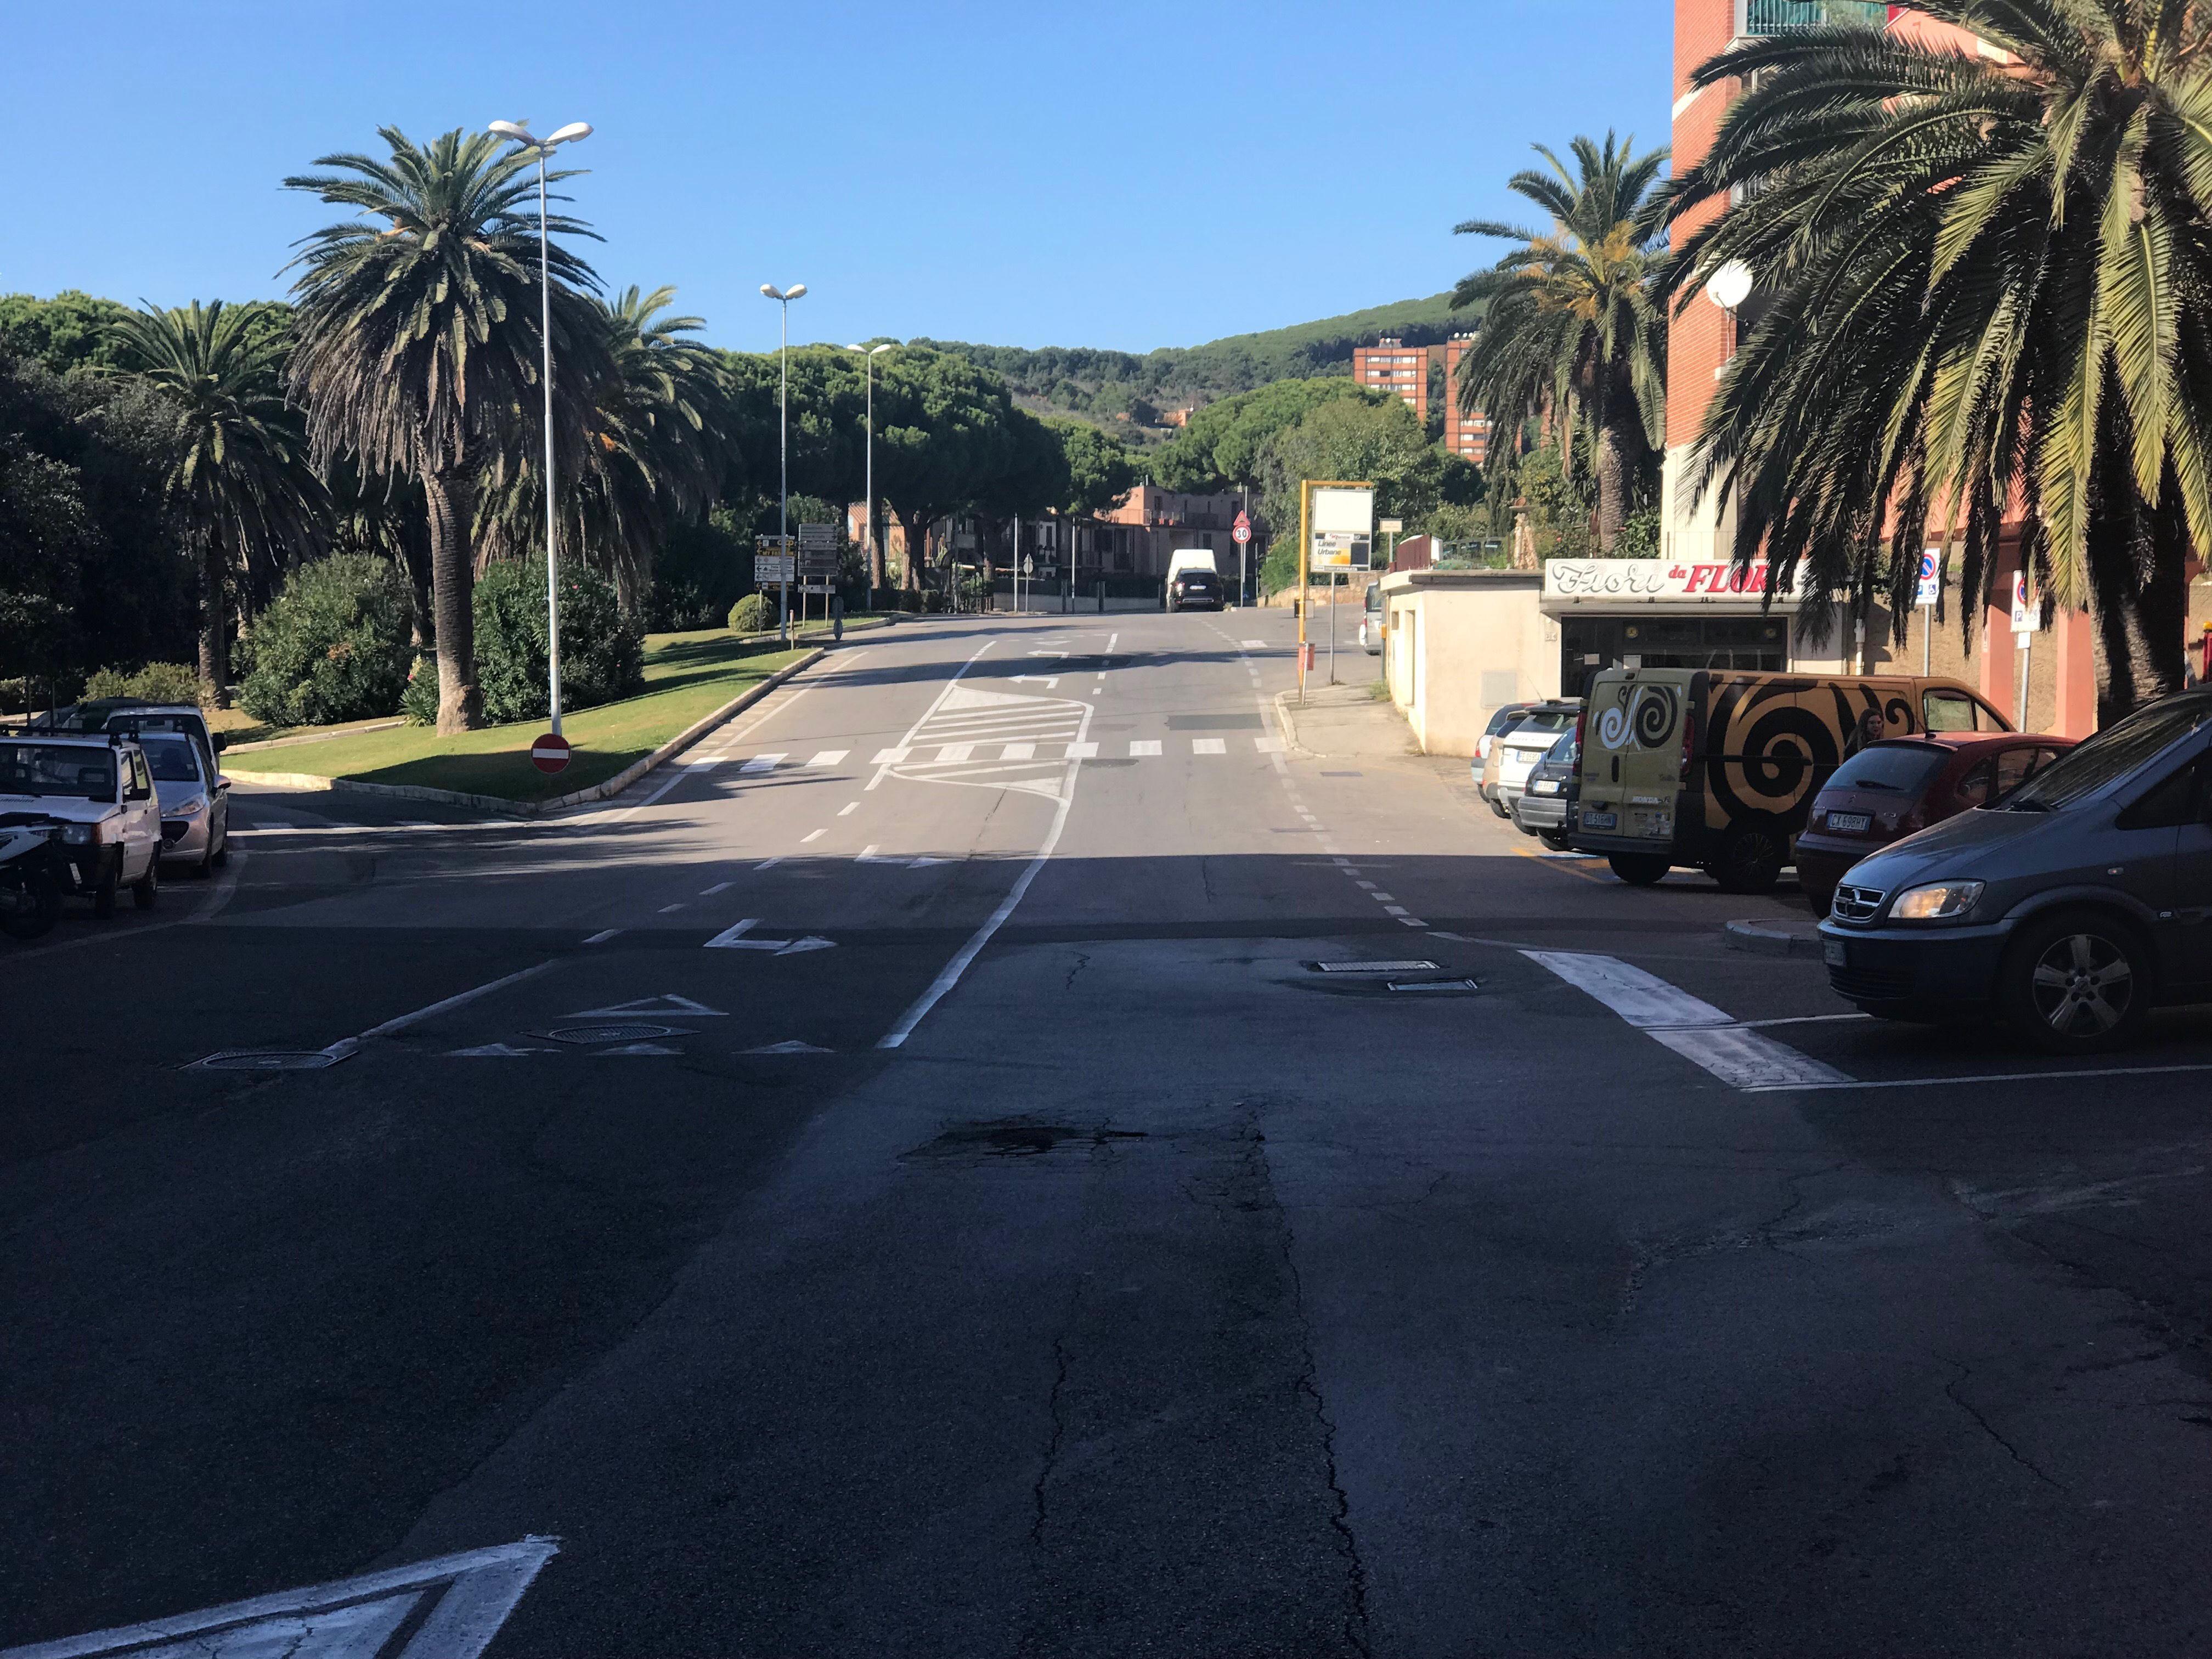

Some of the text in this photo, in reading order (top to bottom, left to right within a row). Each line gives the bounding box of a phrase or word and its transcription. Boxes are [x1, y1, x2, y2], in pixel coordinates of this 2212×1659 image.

[1238, 529, 1246, 538] 30
[1553, 561, 1664, 594] Fiori
[1668, 565, 1686, 578] da
